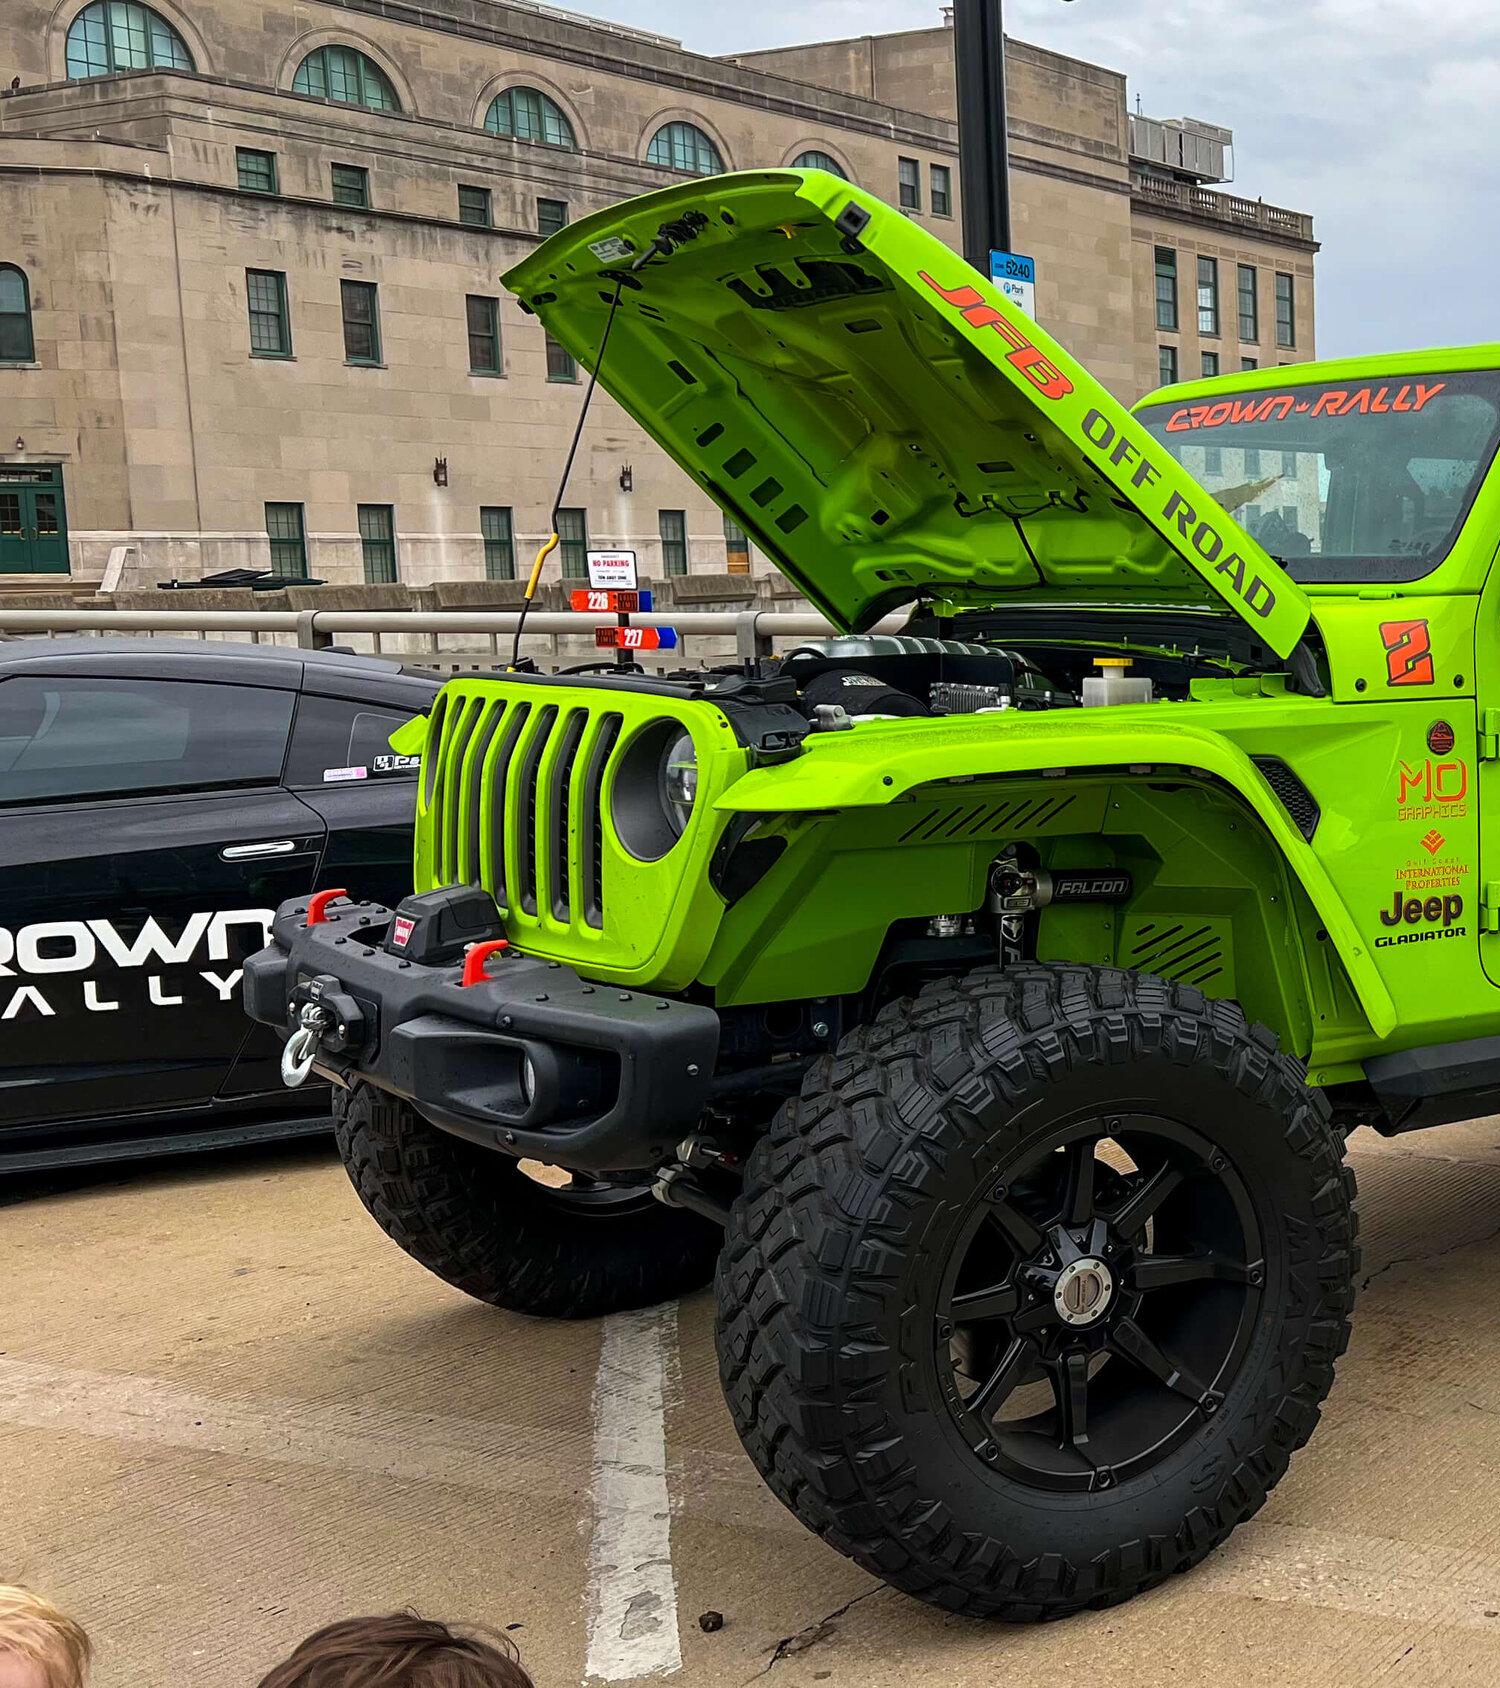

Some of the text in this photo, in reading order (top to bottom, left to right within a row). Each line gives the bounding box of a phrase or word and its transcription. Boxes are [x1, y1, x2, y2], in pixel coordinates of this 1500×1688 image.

[1006, 260, 1030, 278] 5240
[917, 270, 1074, 400] JFB
[1164, 383, 1446, 433] CROWN RALLY
[1081, 408, 1277, 619] OFF ROAD
[588, 592, 608, 610] 226
[624, 629, 642, 646] 227
[1379, 619, 1435, 686] 2
[1398, 804, 1468, 822] GRAPHICS
[1396, 864, 1469, 880] INTERNATIONAL
[1060, 880, 1124, 894] FALCON
[1406, 877, 1461, 890] PROPERTIES
[1379, 890, 1464, 927] Jeep
[1374, 927, 1466, 948] GLADIATOR
